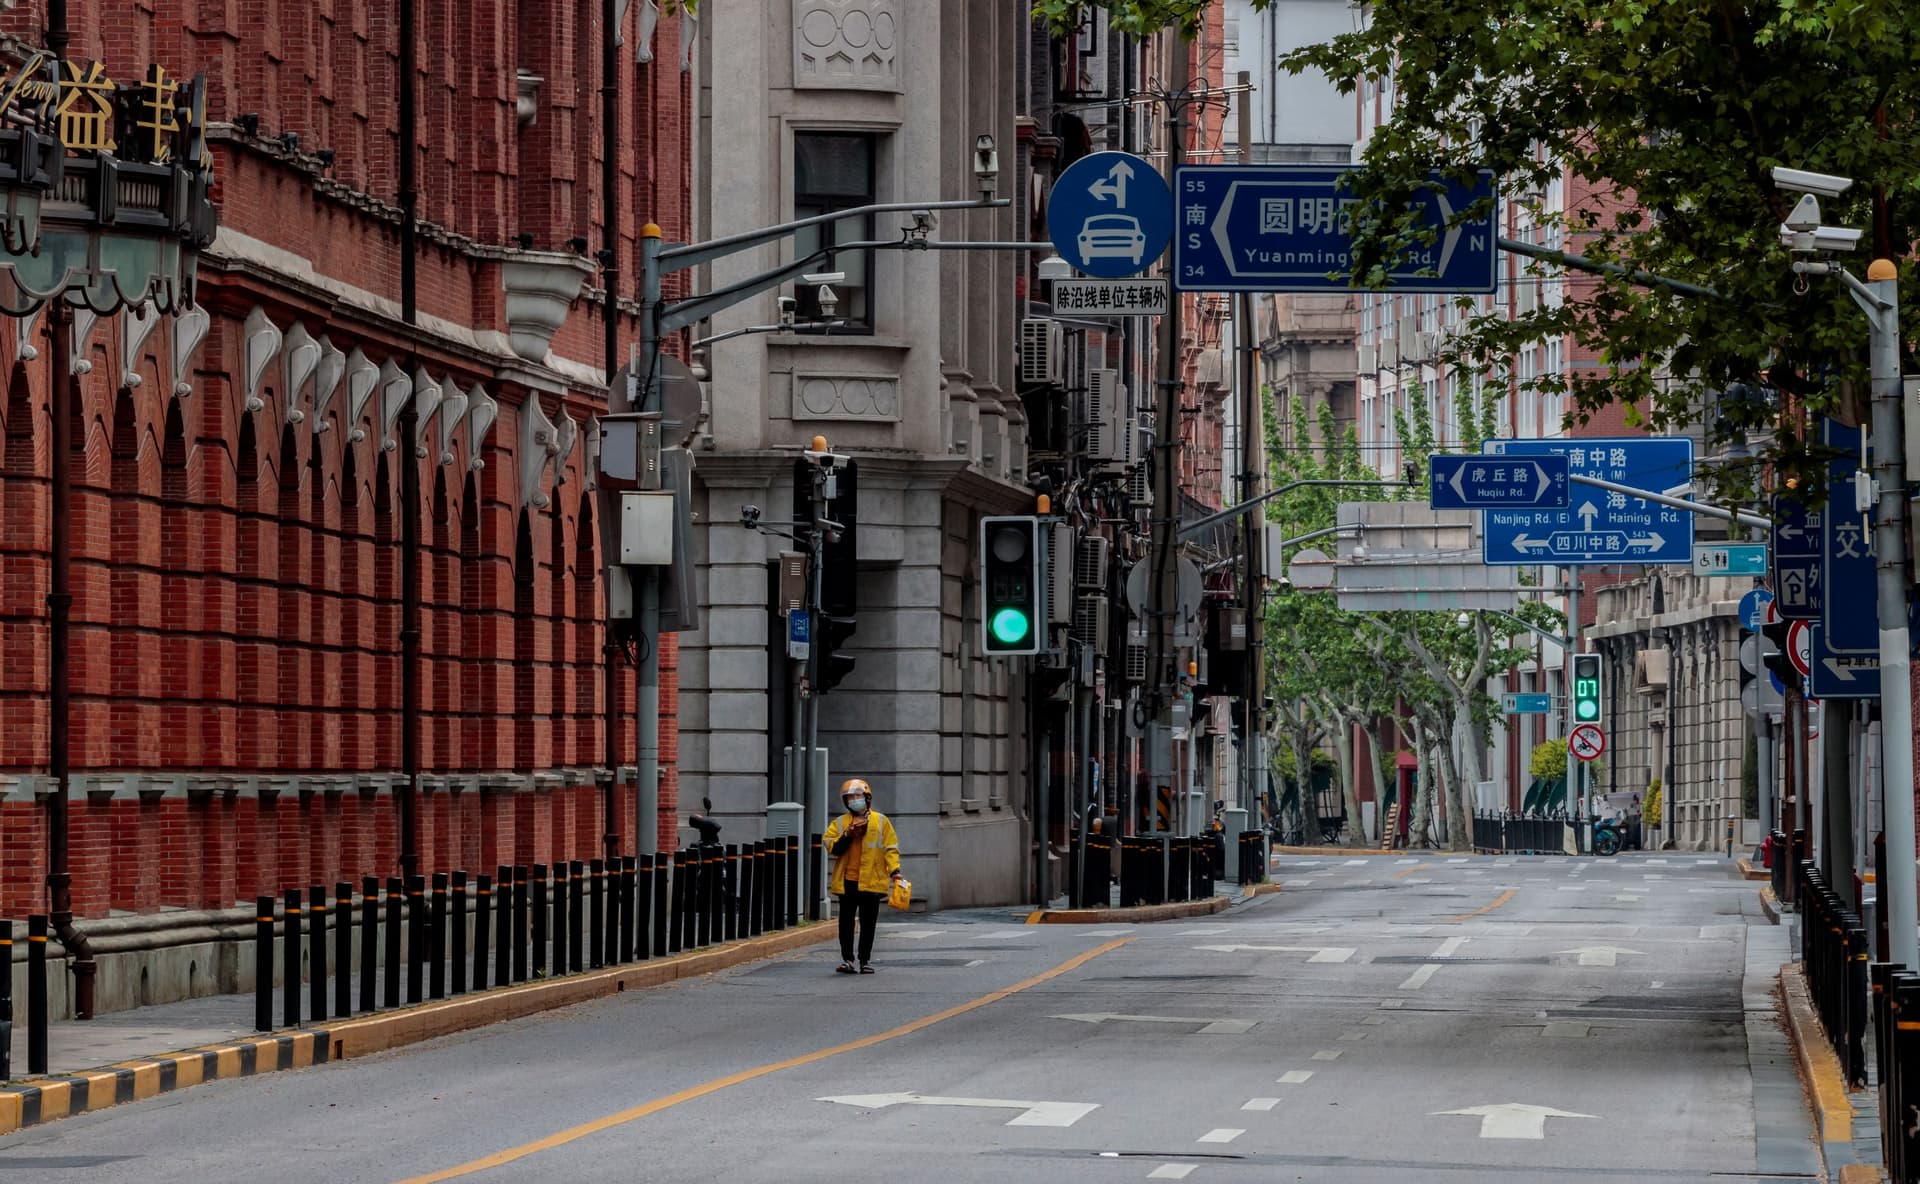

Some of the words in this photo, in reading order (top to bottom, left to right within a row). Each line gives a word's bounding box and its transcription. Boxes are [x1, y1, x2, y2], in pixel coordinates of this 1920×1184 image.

[1186, 181, 1206, 192] 55
[1185, 203, 1207, 225] 南
[1259, 197, 1412, 235] 圆明
[1188, 233, 1202, 249] S
[1471, 235, 1484, 251] N
[1408, 251, 1437, 264] Rd.
[1185, 265, 1205, 277] 34
[1057, 286, 1166, 309] 除沿线单位车辆外
[1550, 447, 1627, 467] 南中路
[1472, 467, 1528, 482] 虎丘路
[1555, 472, 1565, 482] 北
[1610, 470, 1626, 480] (M)
[1478, 488, 1505, 499] Huqiu
[1509, 488, 1526, 496] Rd.
[1493, 513, 1530, 526] Nanjing
[1534, 514, 1552, 524] Rd.
[1556, 513, 1570, 524] (E)
[1608, 511, 1651, 525] Haining
[1660, 511, 1680, 522] Rd.
[1556, 535, 1620, 551] 四川中路
[1578, 680, 1597, 697] 07
